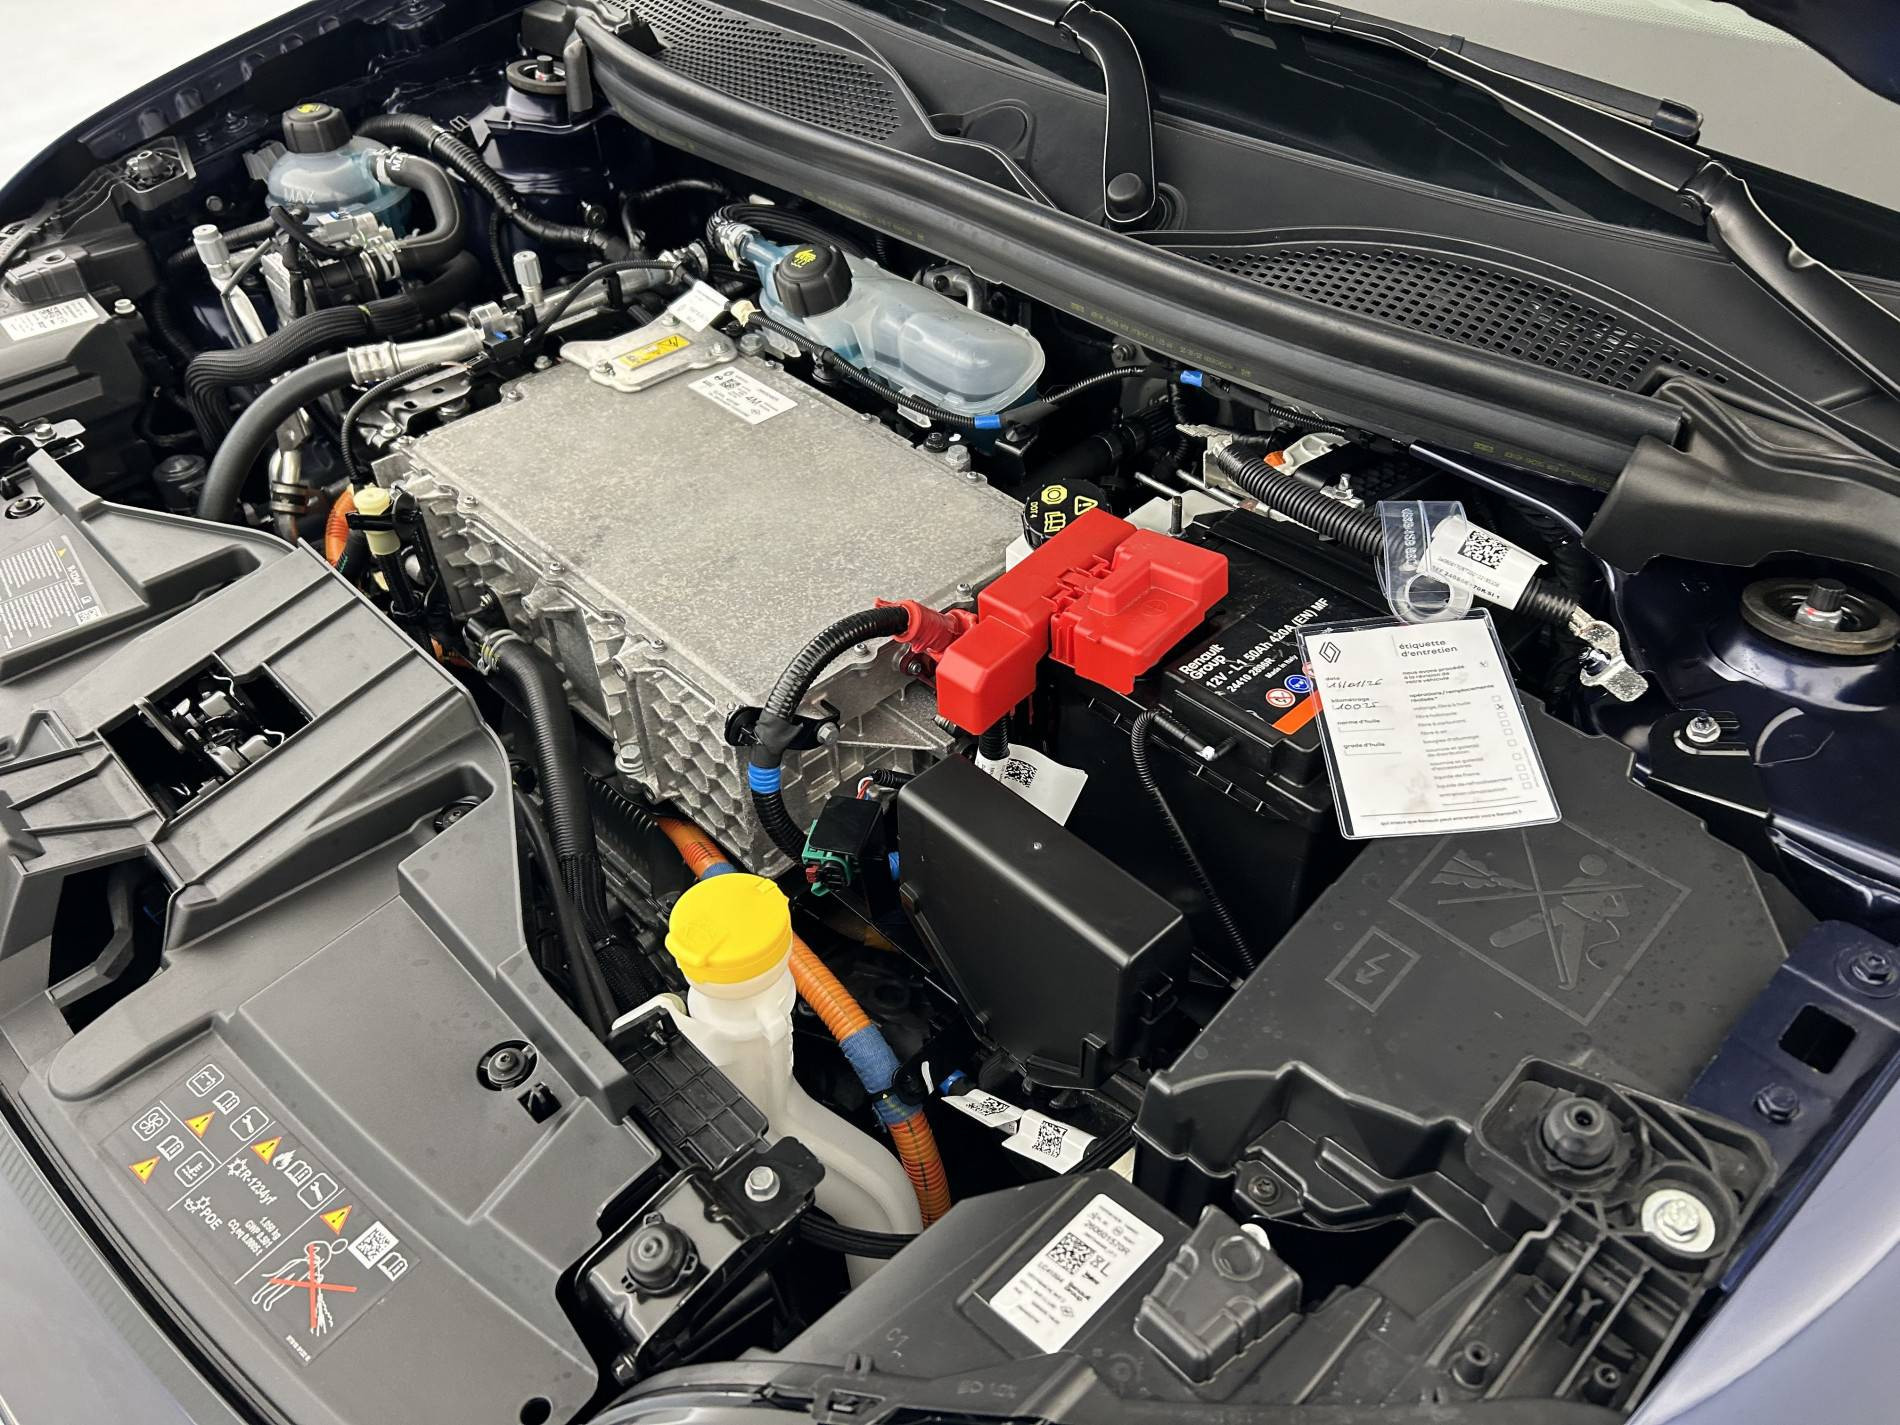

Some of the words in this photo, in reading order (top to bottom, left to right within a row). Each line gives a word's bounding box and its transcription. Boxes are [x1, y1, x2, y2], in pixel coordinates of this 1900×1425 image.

[1030, 501, 1038, 514] DOT
[1206, 671, 1228, 689] 12V
[1230, 658, 1248, 671] L1
[1243, 641, 1273, 661] 50Ah
[1269, 624, 1296, 643] 420A
[1292, 609, 1318, 628] (EN)
[1310, 597, 1329, 613] MF
[1399, 640, 1446, 650] étiquette
[1401, 646, 1458, 657] d'entretien
[1179, 643, 1225, 675] Renault
[1189, 655, 1226, 680] Group
[1264, 669, 1278, 679] Made
[1283, 654, 1299, 667] Italy
[1227, 674, 1252, 693] 24410
[240, 1169, 278, 1205] R-1234yf
[199, 1207, 223, 1231] POE
[245, 1220, 260, 1235] GWP
[271, 1228, 282, 1241] kg
